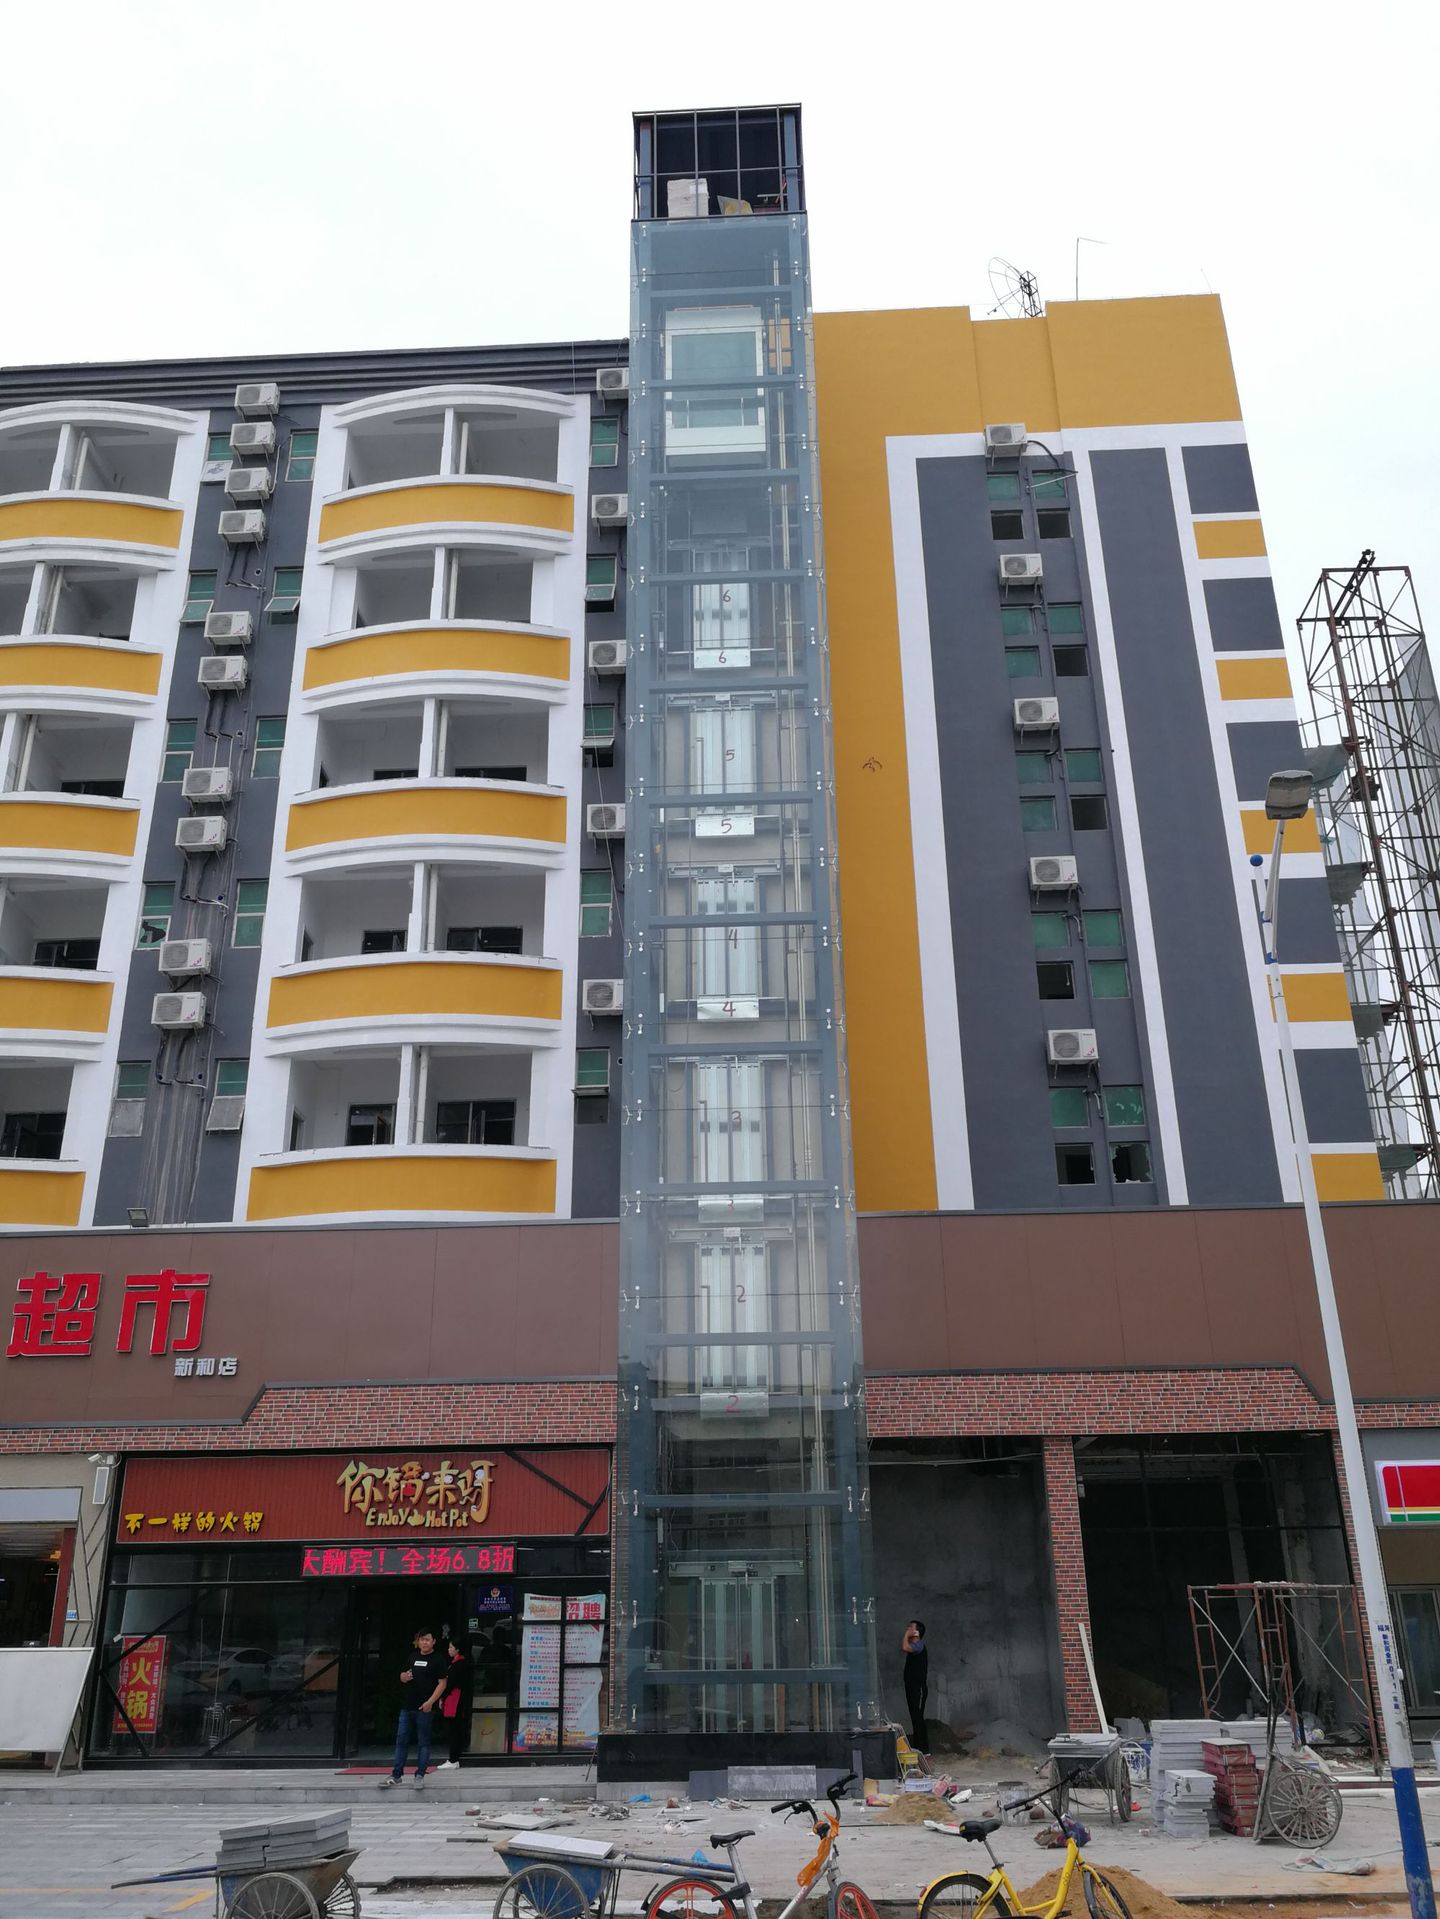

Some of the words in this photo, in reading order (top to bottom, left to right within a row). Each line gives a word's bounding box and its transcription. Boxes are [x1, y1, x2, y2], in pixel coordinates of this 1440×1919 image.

[722, 589, 732, 603] 6
[718, 651, 727, 664] 6
[725, 749, 736, 762] 5
[720, 818, 732, 834] 5
[728, 928, 738, 949] 4
[722, 1001, 737, 1017] 4
[736, 1284, 747, 1303] 2
[6, 1269, 211, 1357] 超市
[174, 1357, 239, 1377] 新和店
[725, 1395, 741, 1414] 2
[125, 1511, 264, 1535] 不一样的火锅
[127, 1657, 152, 1720] 火锅
